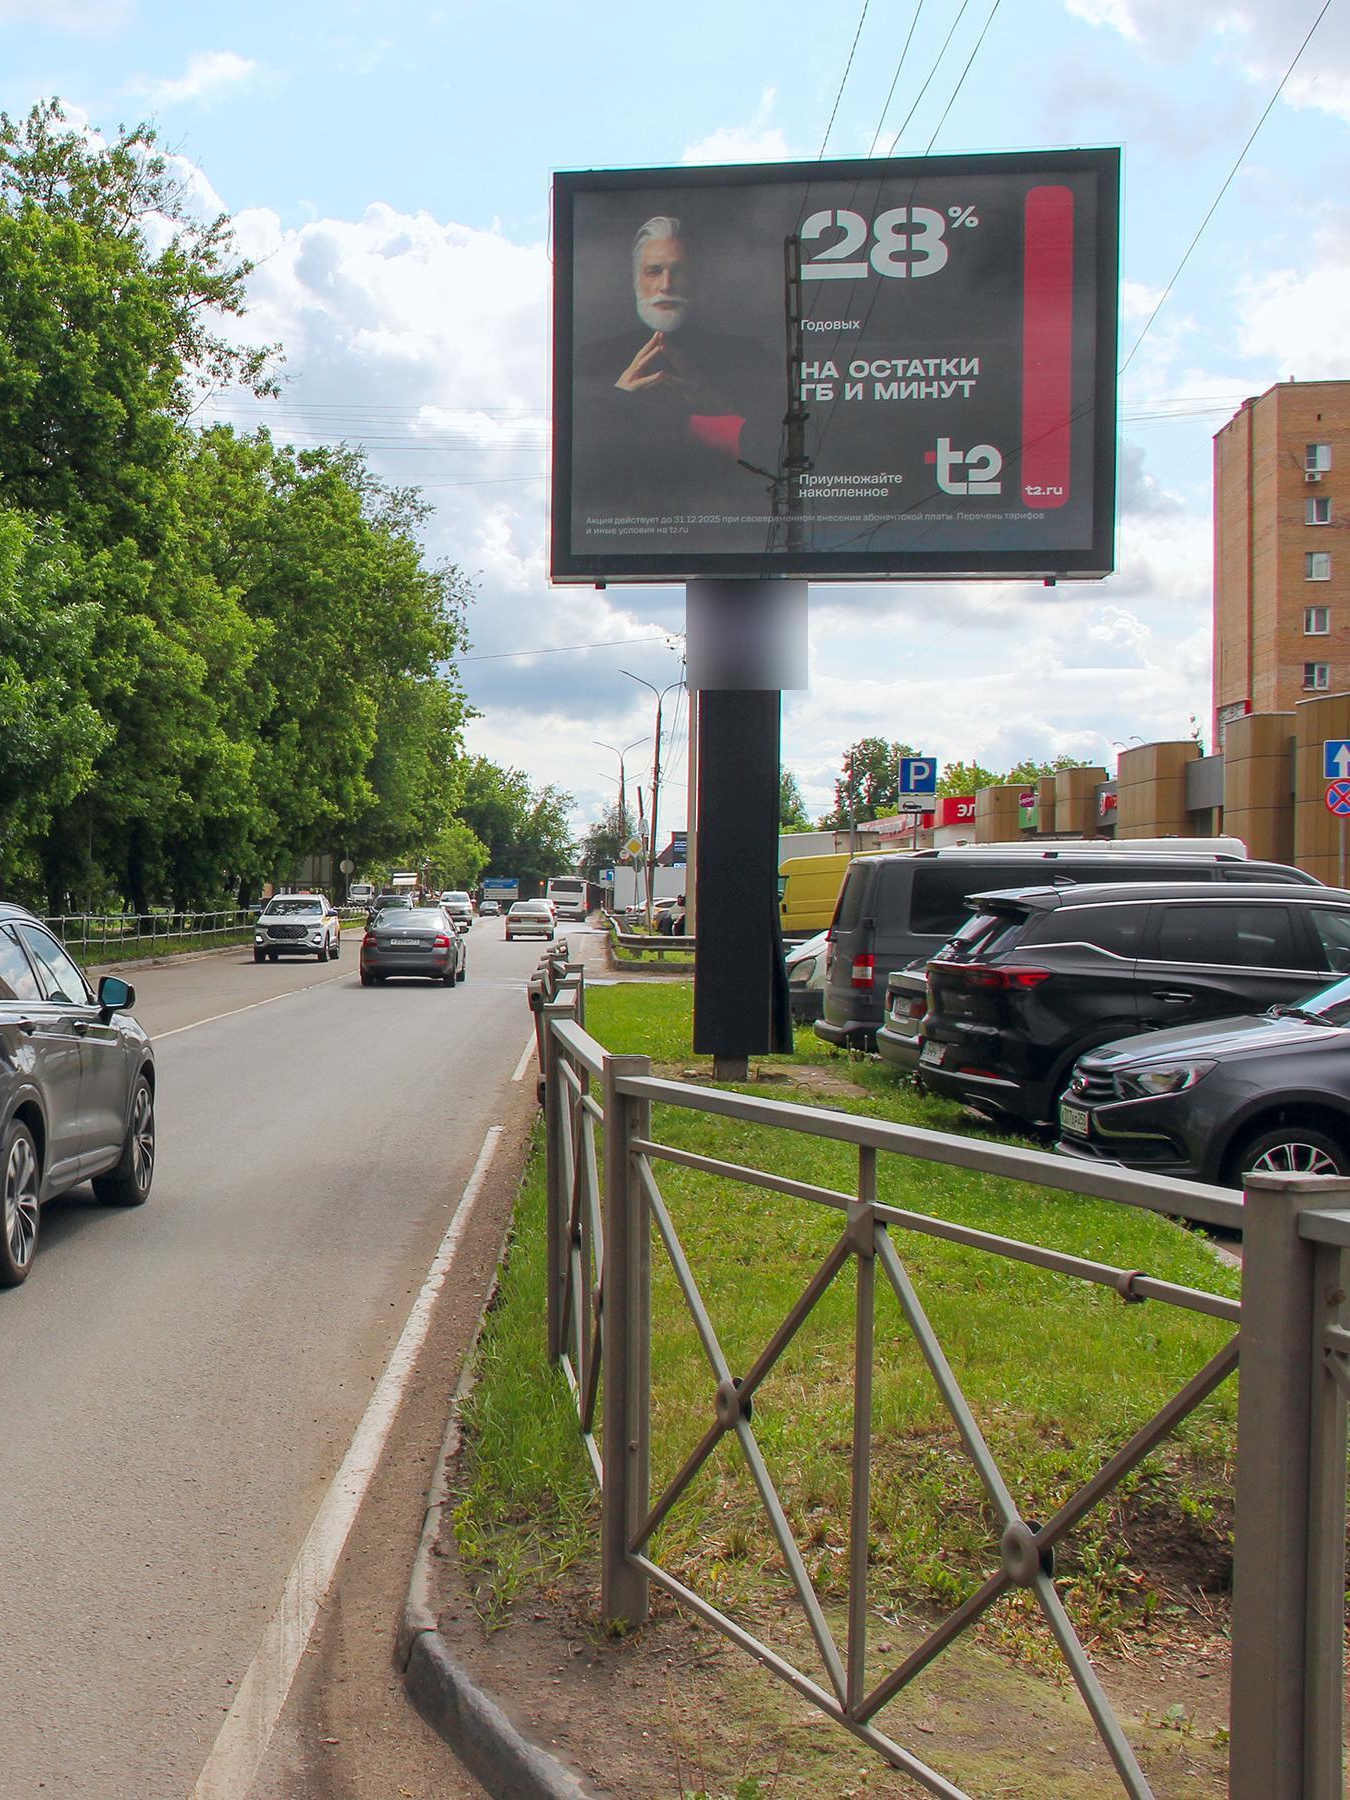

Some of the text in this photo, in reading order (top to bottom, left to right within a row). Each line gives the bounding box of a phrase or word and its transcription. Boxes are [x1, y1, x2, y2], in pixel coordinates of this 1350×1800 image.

[800, 319, 860, 333] Годовых
[800, 358, 979, 379] НА ОСТАТКИ
[800, 380, 976, 401] ГБ И МИНУТ
[924, 437, 1002, 495] t2
[799, 472, 903, 486] Приумножайте
[799, 487, 889, 498] накопленное
[1024, 485, 1063, 496] t2.ru
[586, 516, 612, 525] Акция
[614, 516, 660, 525] действует
[661, 516, 673, 524] до
[722, 515, 739, 524] при
[817, 514, 862, 522] внесении
[863, 512, 923, 521] абонентской
[957, 511, 1003, 520] Перечень
[1004, 511, 1045, 520] тарифов
[618, 527, 655, 536] условия
[657, 526, 668, 534] на
[909, 762, 930, 789] P
